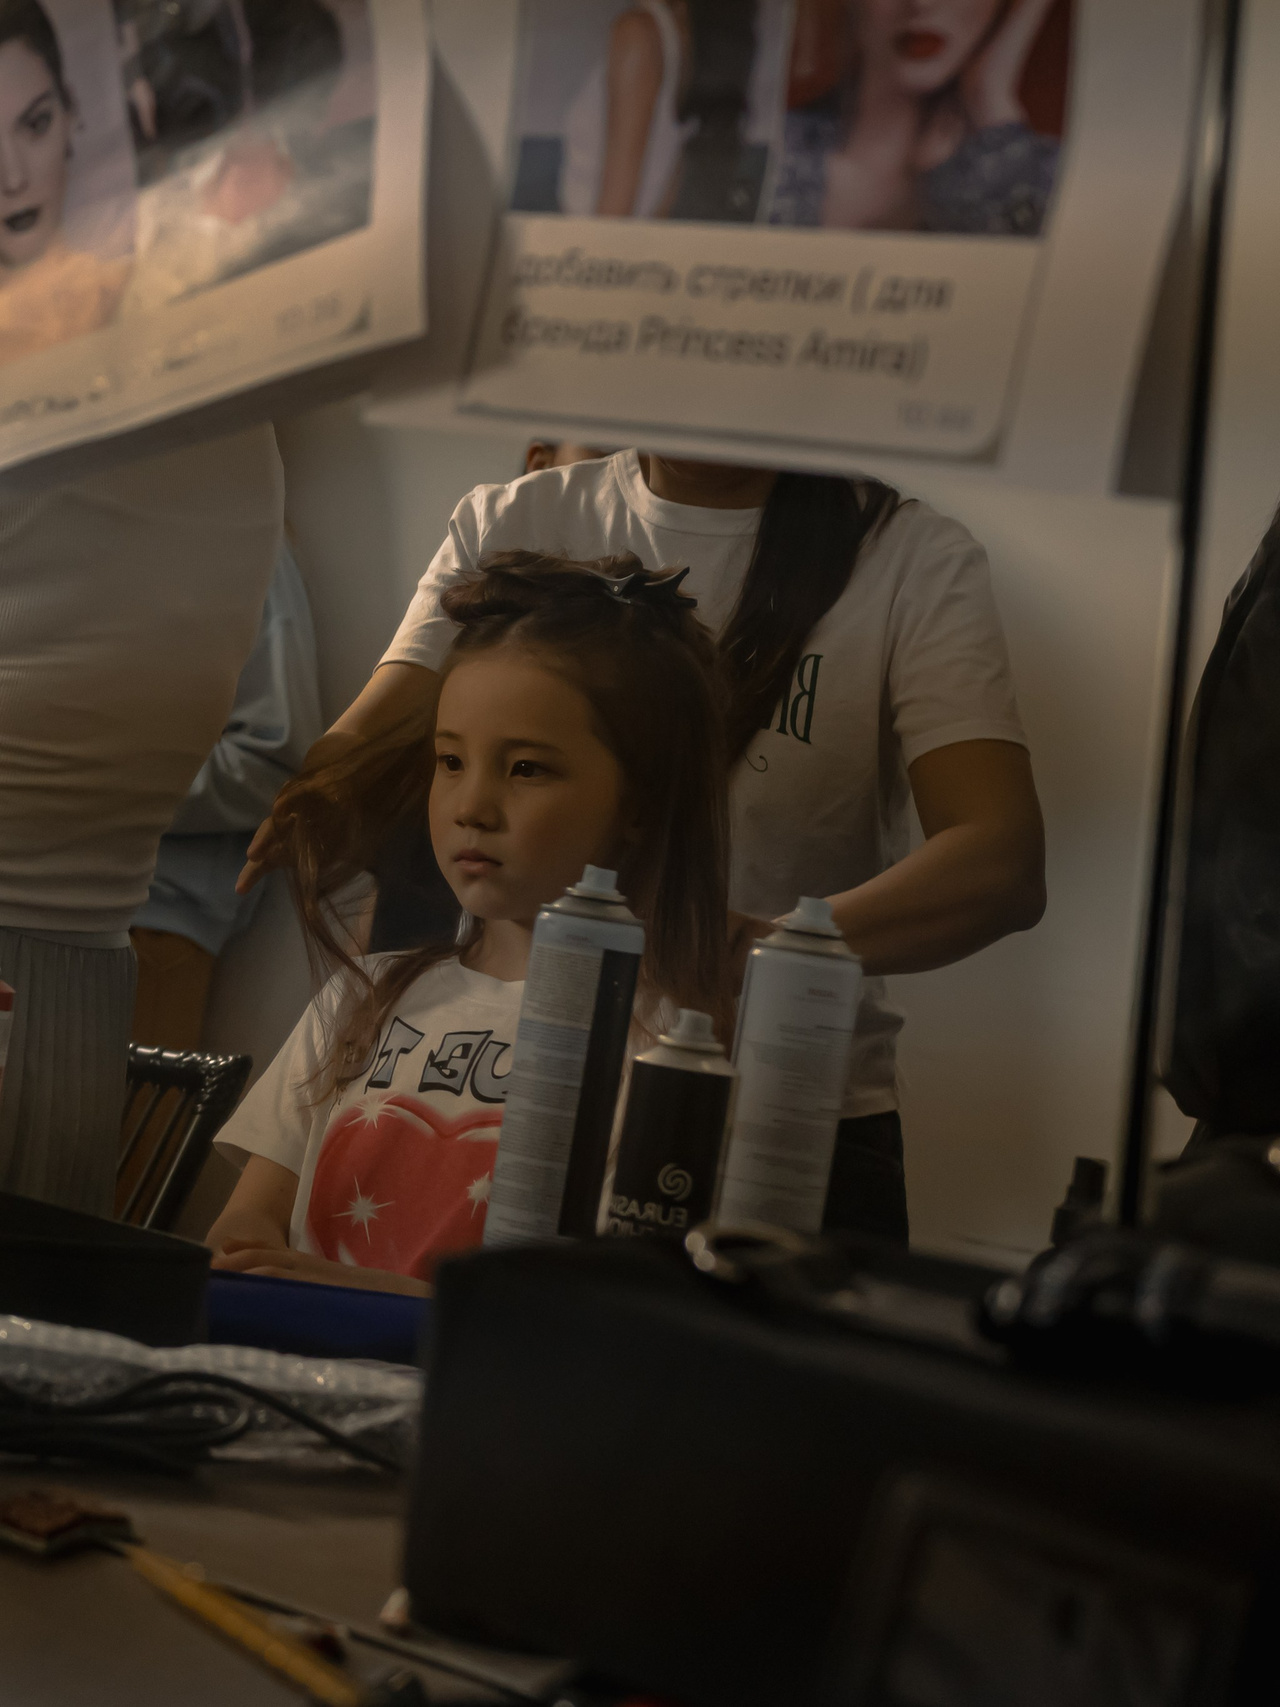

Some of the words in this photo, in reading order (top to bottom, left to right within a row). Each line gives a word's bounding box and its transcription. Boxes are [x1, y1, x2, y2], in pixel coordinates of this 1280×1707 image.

[685, 263, 848, 304] стрелки
[873, 275, 955, 314] для
[636, 314, 793, 367] Princess
